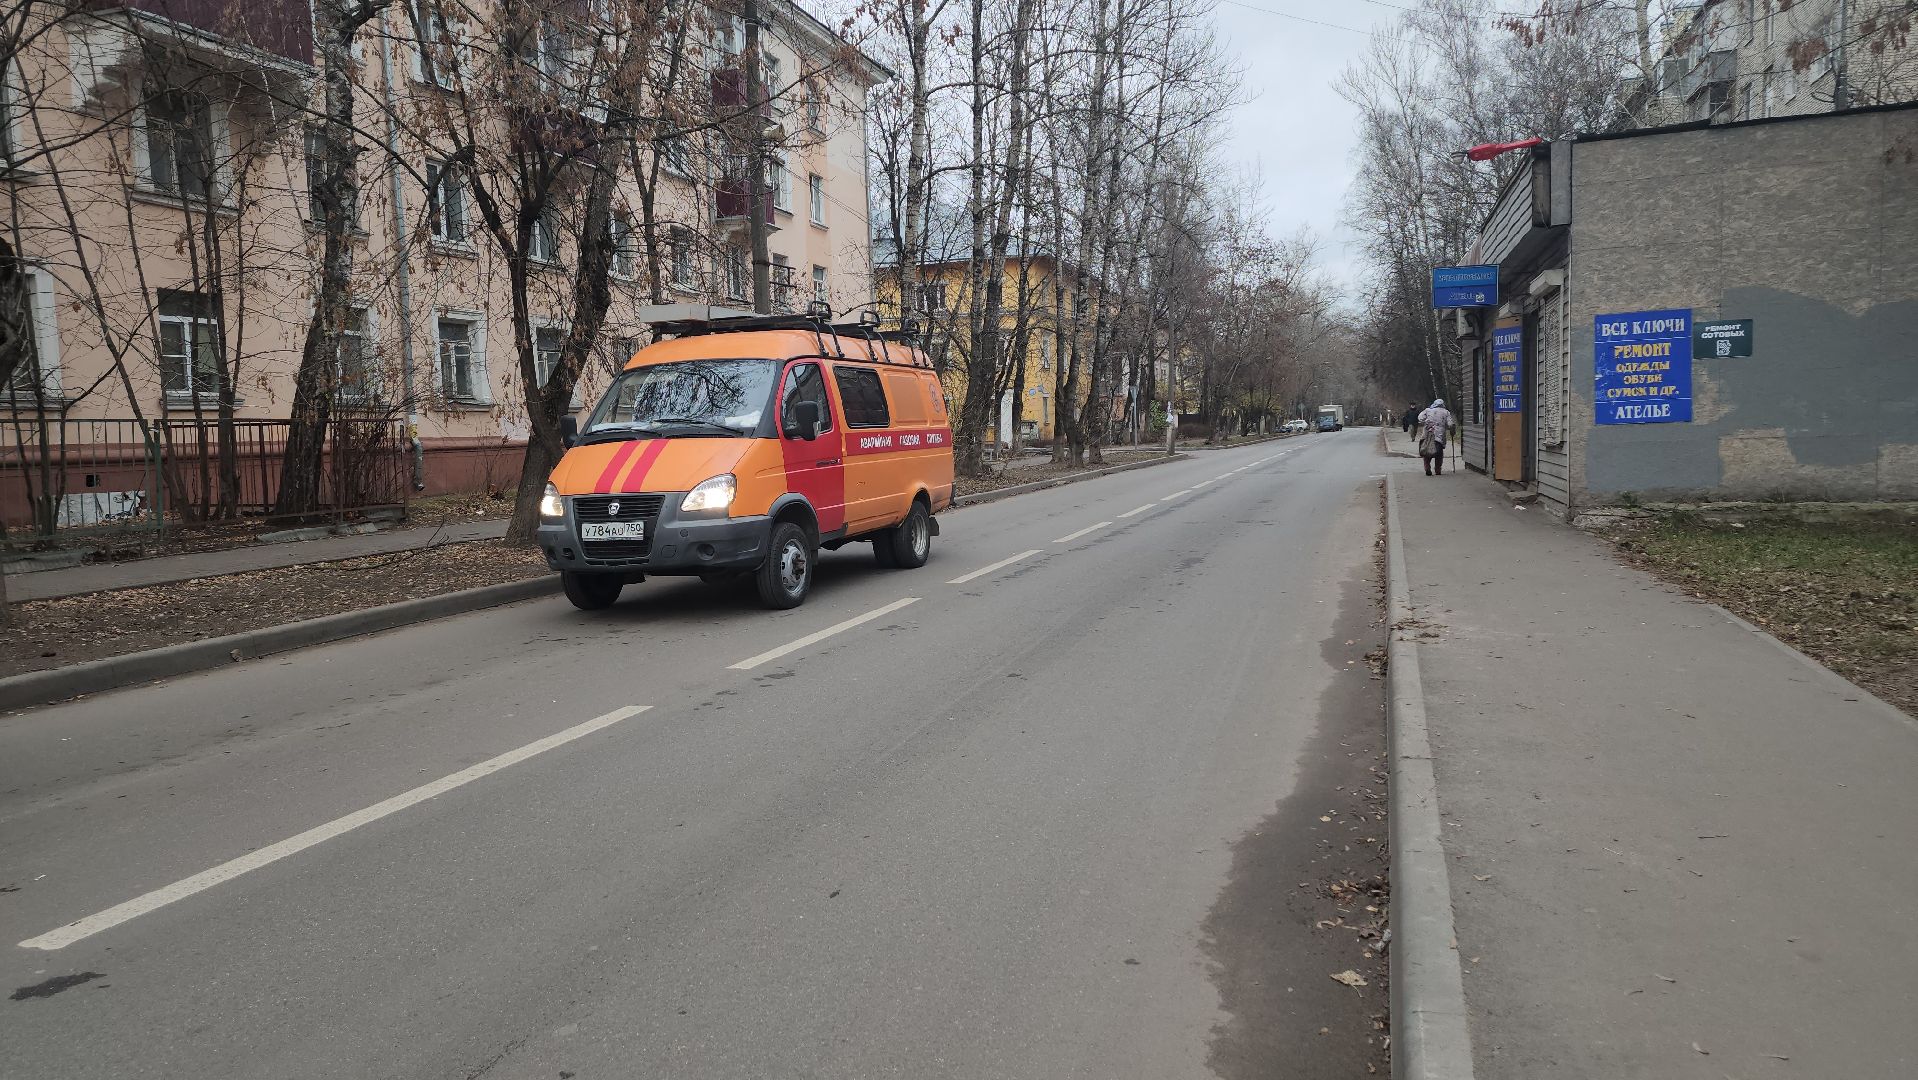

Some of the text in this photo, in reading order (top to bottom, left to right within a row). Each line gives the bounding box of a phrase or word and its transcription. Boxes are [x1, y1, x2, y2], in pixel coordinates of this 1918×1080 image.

[1602, 318, 1685, 337] ВСЕ КЛЮЧИ
[1705, 324, 1742, 332] РЕМОНТ
[1701, 330, 1745, 339] СОТОВЫХ
[1614, 342, 1672, 359] РЕМОНТ
[1615, 361, 1671, 374] ОДЕЖДЫ
[1649, 385, 1659, 397] И
[1659, 384, 1680, 397] ДР.
[1615, 403, 1672, 420] АТЕЛЬЕ
